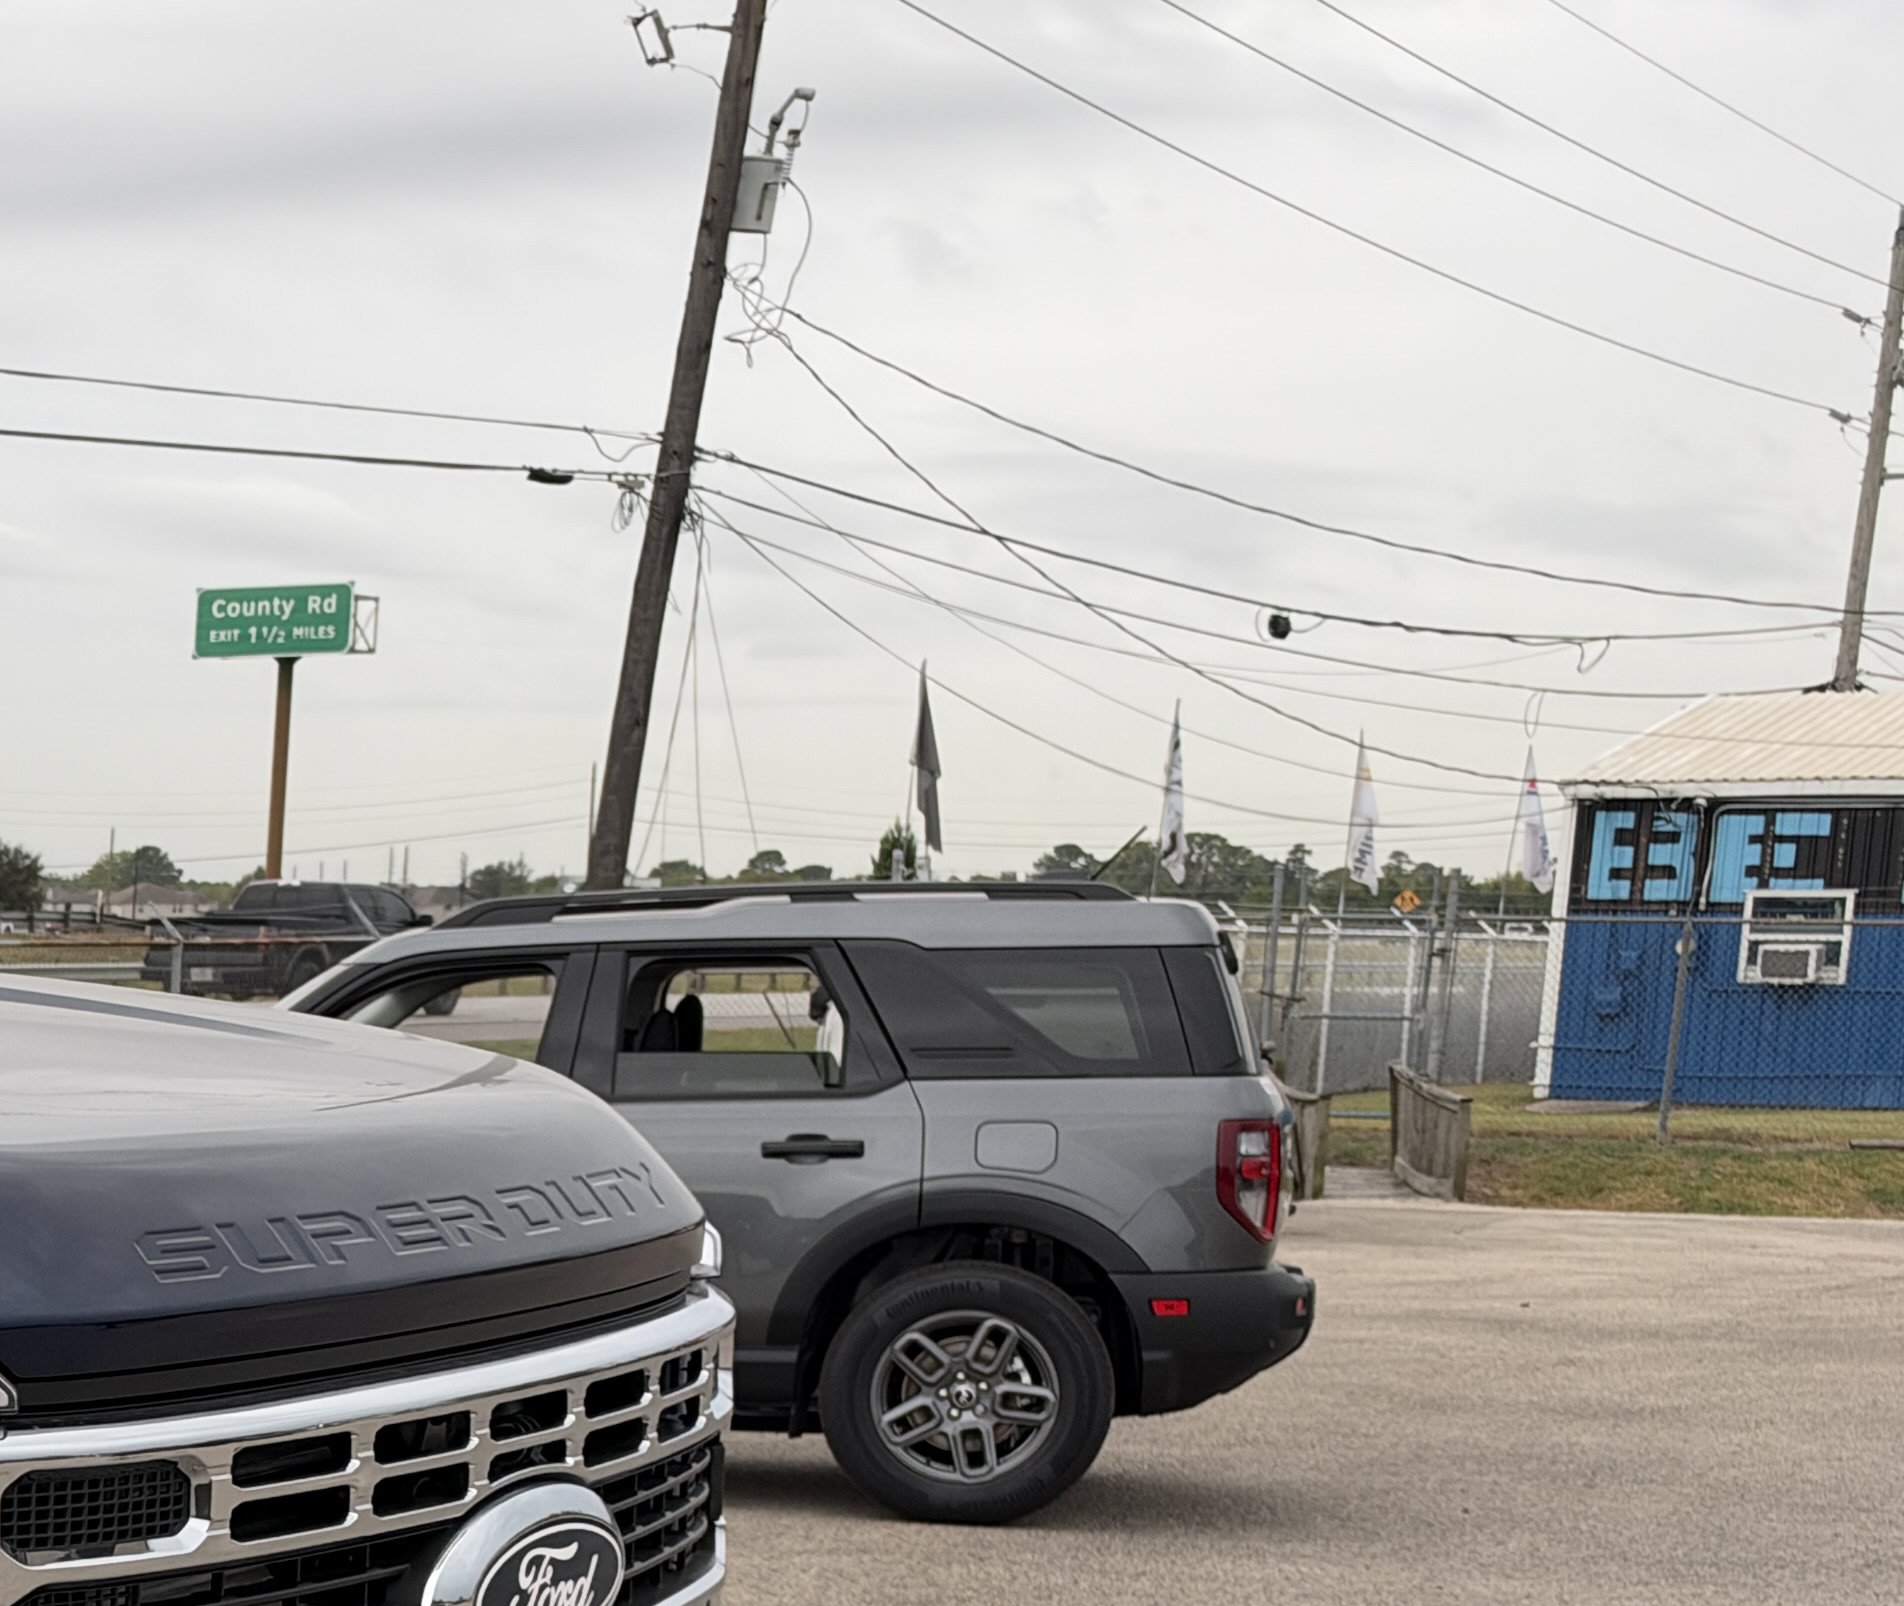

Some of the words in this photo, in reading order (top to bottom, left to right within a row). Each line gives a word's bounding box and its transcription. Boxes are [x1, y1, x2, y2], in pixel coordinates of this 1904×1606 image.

[211, 596, 296, 621] County
[307, 592, 338, 615] Rd
[209, 628, 241, 643] EXIT
[292, 624, 337, 640] MILES
[133, 1194, 508, 1284] SUPER
[496, 1162, 666, 1236] DUTY
